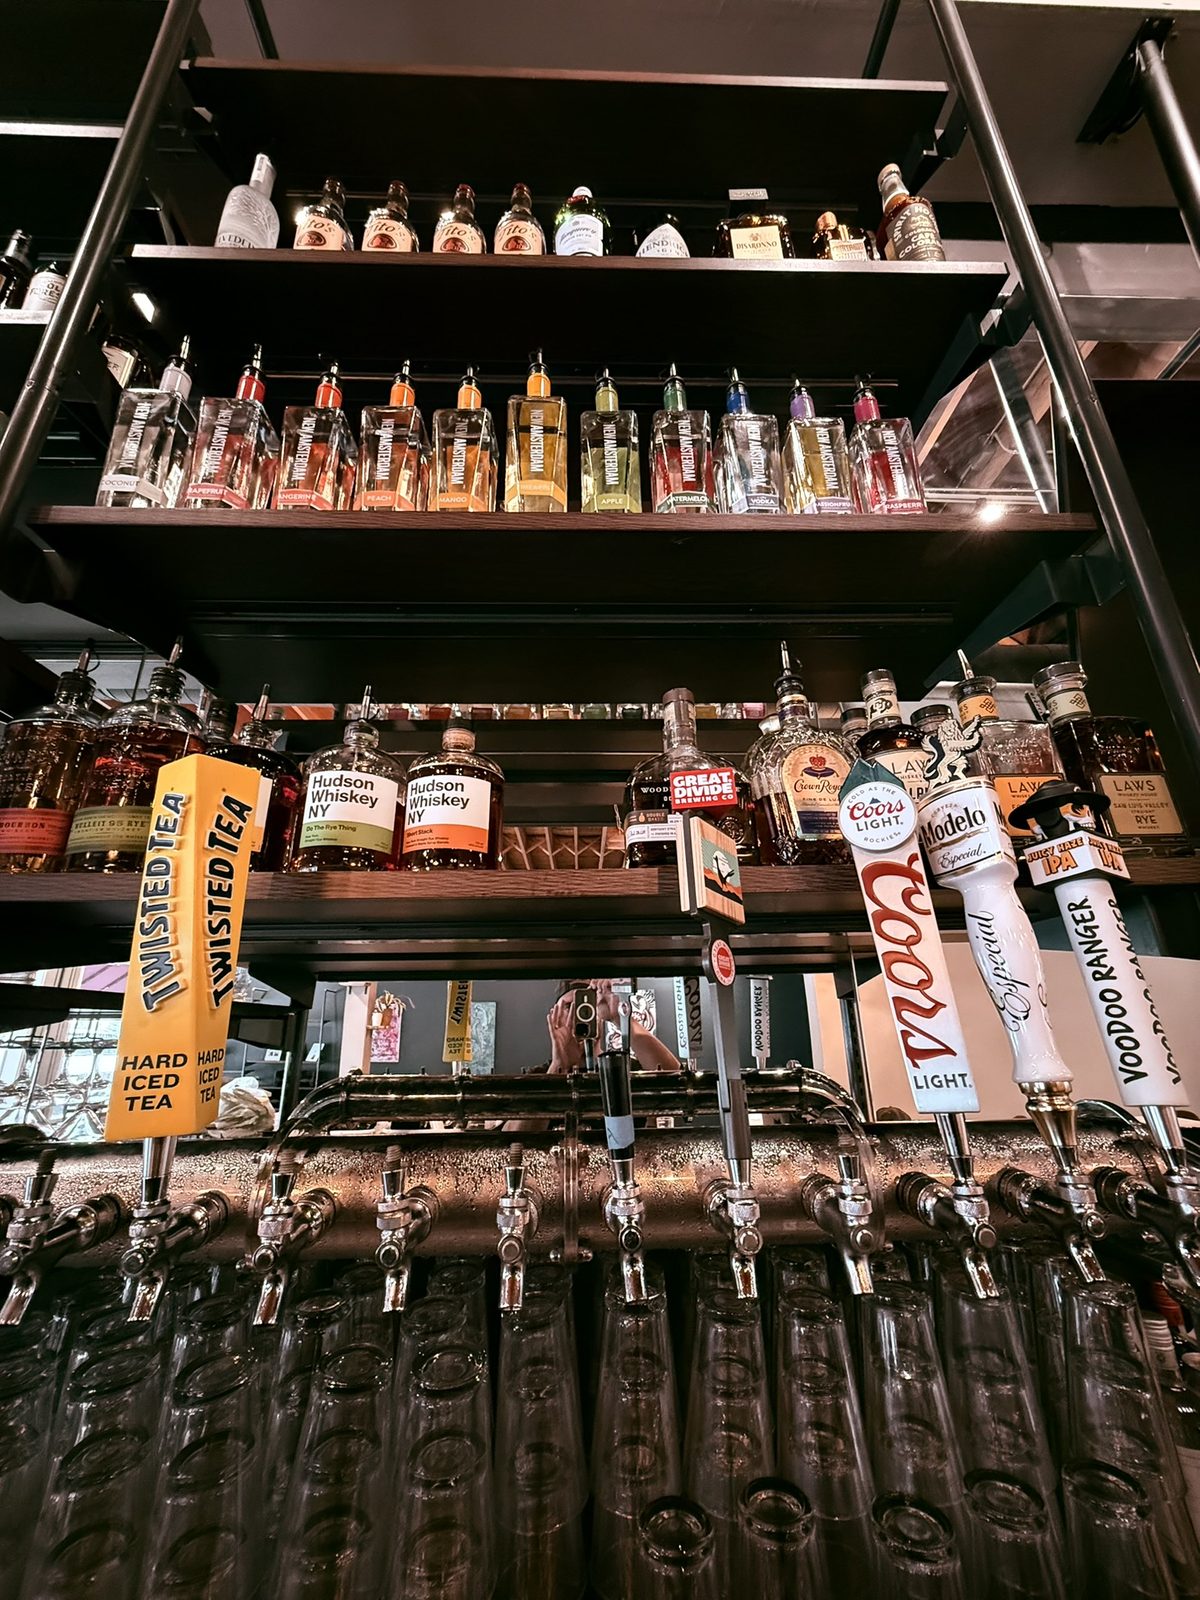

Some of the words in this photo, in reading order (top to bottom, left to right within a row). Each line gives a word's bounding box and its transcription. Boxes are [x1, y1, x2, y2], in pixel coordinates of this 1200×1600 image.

[893, 209, 912, 243] SPIRIT
[736, 241, 777, 250] DISARONNO
[136, 402, 151, 419] NEW
[220, 409, 233, 424] NEW
[530, 409, 544, 425] NEW
[302, 417, 317, 434] NEW
[381, 418, 395, 433] NEW
[454, 421, 468, 438] NEW
[603, 424, 617, 439] NEW
[677, 419, 692, 435] NEW
[747, 424, 762, 441] NEW
[815, 427, 830, 443] NEW
[881, 430, 898, 446] NEW
[205, 421, 230, 474] AMSTERDAM
[291, 432, 314, 481] AMSTERDAM
[375, 432, 393, 480] AMSTERDAM
[530, 424, 544, 472] AMSTERDAM
[450, 437, 467, 485] AMSTERDAM
[604, 438, 619, 485] AMSTERDAM
[679, 434, 696, 482] AMSTERDAM
[749, 440, 768, 488] AMSTERDAM
[819, 441, 839, 490] AMSTERDAM
[891, 759, 927, 775] LAW
[312, 774, 375, 791] Hudson
[410, 779, 465, 797] Hudson
[672, 772, 732, 788] GREAT
[793, 779, 820, 793] Crown
[1112, 780, 1156, 792] LAWS
[311, 789, 379, 809] Whiskey
[640, 786, 671, 794] WOOD
[674, 783, 733, 798] DIVIDE
[848, 789, 865, 804] COLD
[882, 786, 896, 795] THE
[409, 793, 470, 811] Whiskey
[675, 795, 718, 805] BREWING
[308, 804, 331, 819] NY
[407, 809, 425, 826] NY
[847, 799, 906, 821] Coors
[931, 803, 959, 818] CERVEZA
[74, 820, 106, 830] BULLEIT
[108, 820, 124, 828] 95
[126, 820, 147, 829] RYE
[148, 792, 186, 853] TEA
[207, 794, 254, 855] TEA
[325, 824, 338, 832] Rye
[338, 824, 357, 832] Thing
[856, 815, 901, 832] LIGHT
[920, 806, 986, 849] Modelo
[1135, 815, 1158, 825] RYE
[939, 843, 983, 869] Especial
[1027, 847, 1055, 863] JUICY
[1058, 836, 1085, 853] HAZE
[1041, 849, 1079, 877] IPA
[1098, 848, 1124, 872] IPA
[139, 856, 181, 1012] TWISTED
[207, 856, 235, 1010] TWISTED
[1067, 896, 1118, 982] RANGER
[861, 852, 958, 1070] Coors
[967, 910, 1031, 1033] Especial
[1099, 988, 1149, 1085] VOODOO
[121, 1053, 188, 1071] HARD
[197, 1048, 225, 1066] HARD
[123, 1073, 180, 1091] ICED
[199, 1067, 220, 1085] ICED
[913, 1073, 970, 1090] LIGHT
[125, 1095, 173, 1112] TEA
[200, 1088, 216, 1104] TEA
